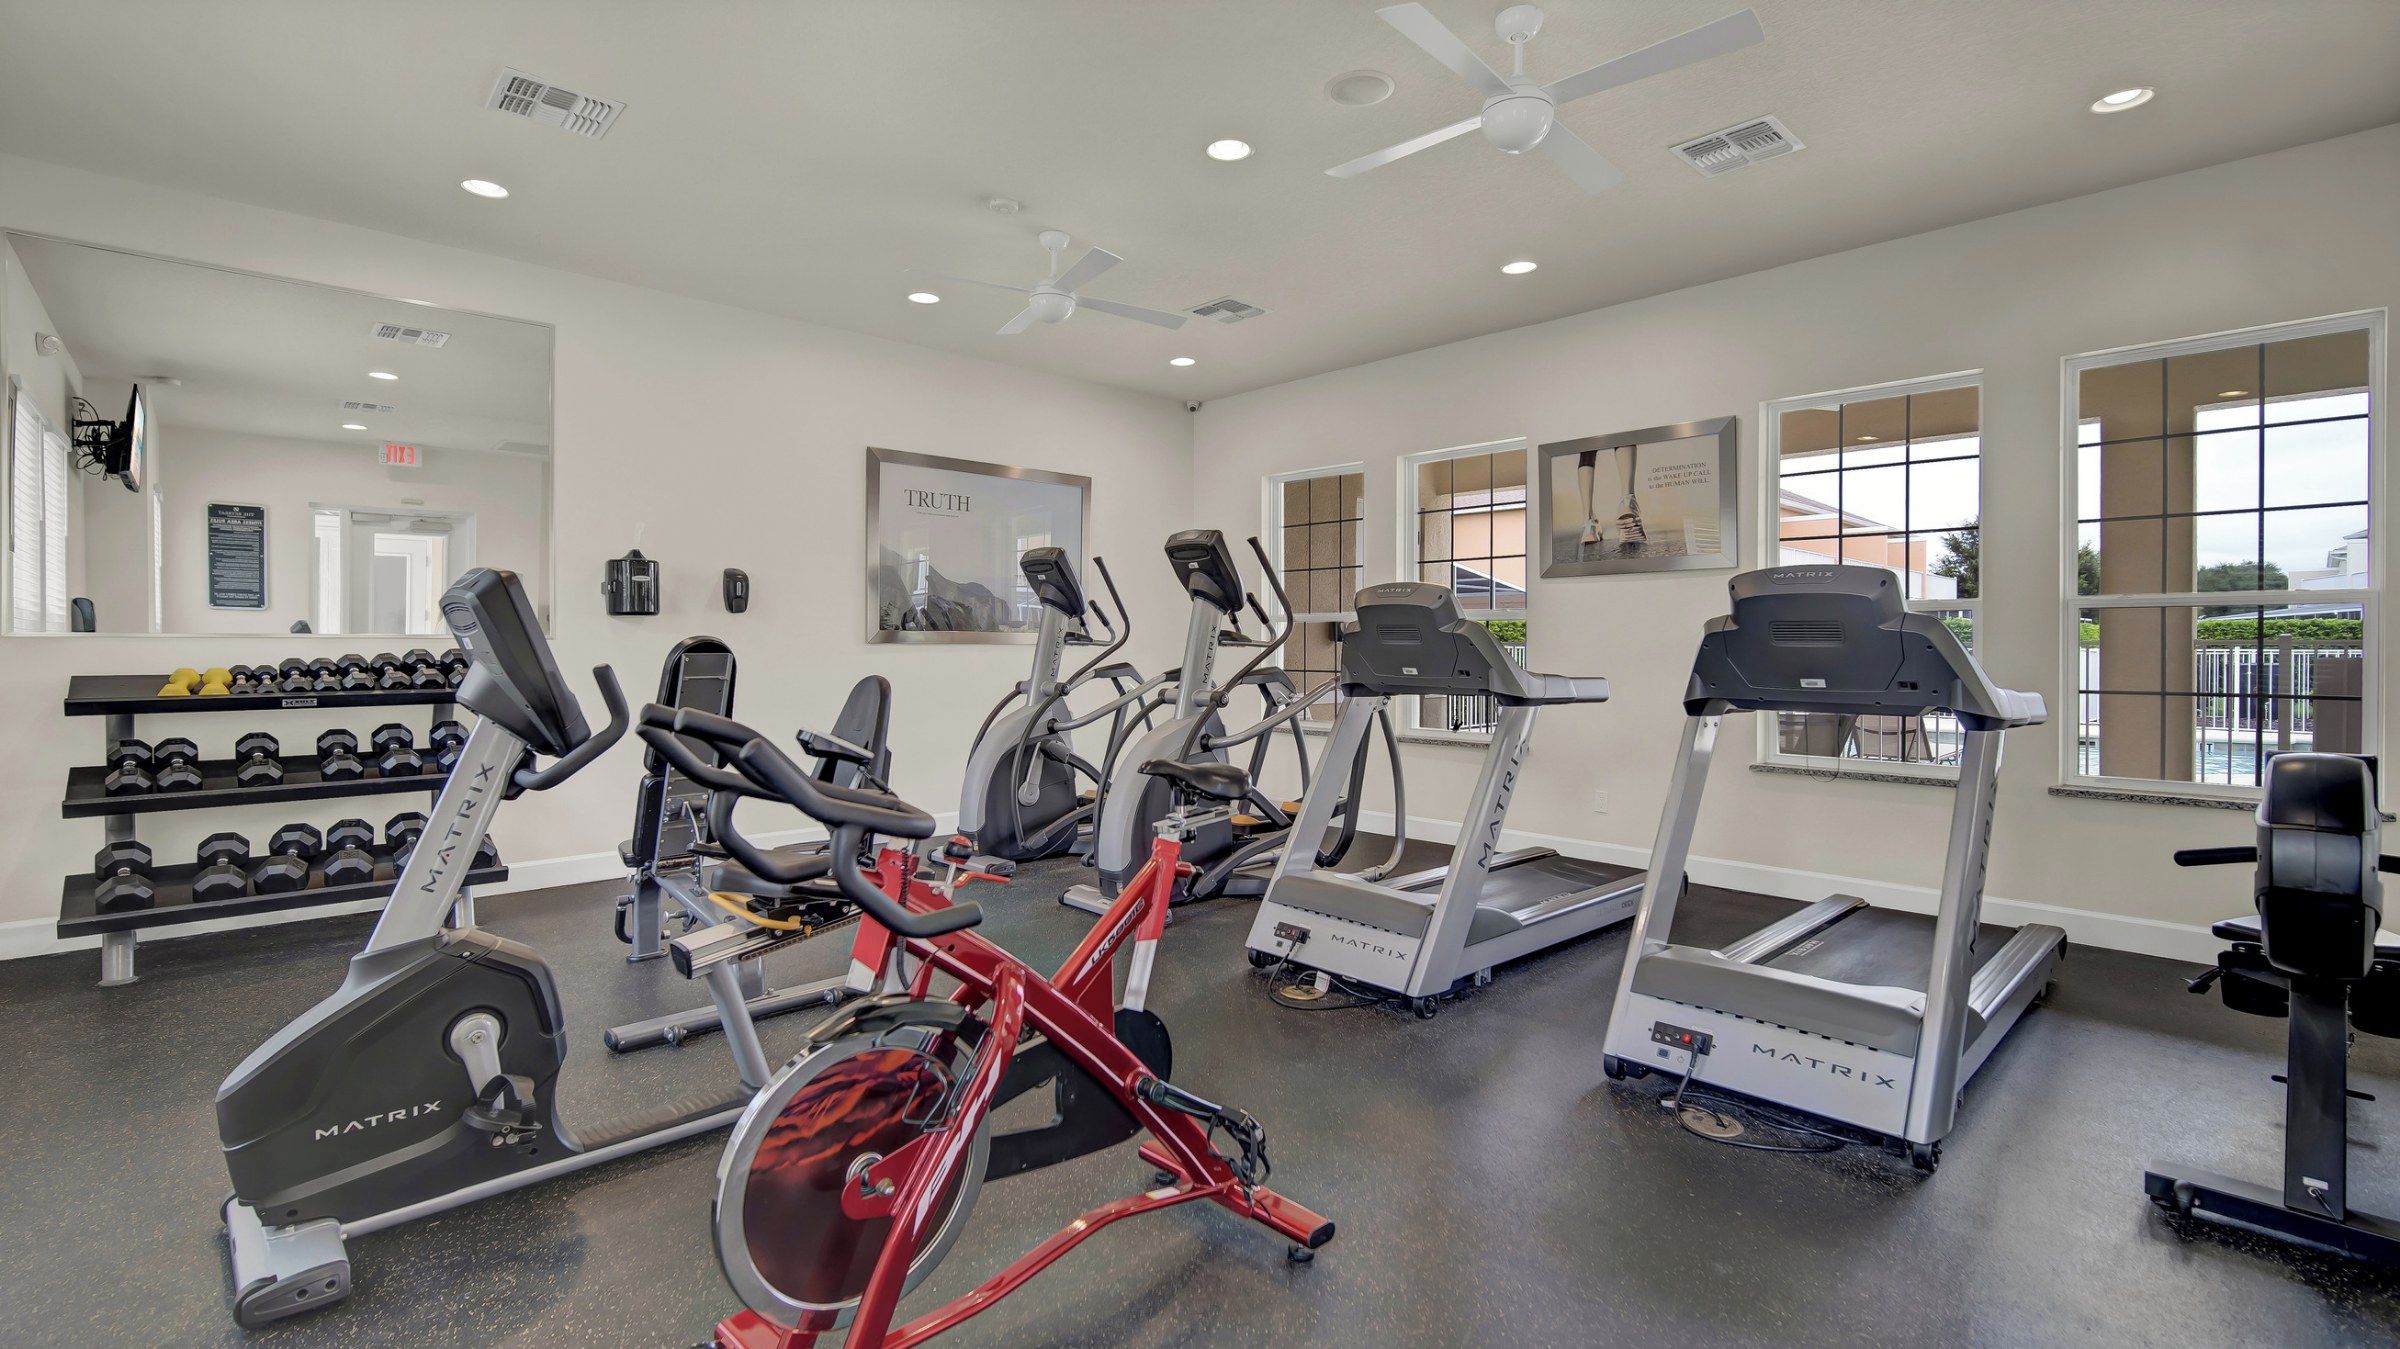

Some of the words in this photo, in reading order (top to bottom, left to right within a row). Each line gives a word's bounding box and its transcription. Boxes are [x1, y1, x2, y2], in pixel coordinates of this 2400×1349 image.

[1652, 462, 1706, 474] DETERMINATION
[1662, 472, 1682, 480] WAKE
[1693, 469, 1711, 477] CALL
[1664, 479, 1690, 488] HUMAN
[904, 490, 970, 512] TRUTH
[1773, 571, 1833, 579] MATRIX
[1050, 627, 1063, 677] MATRIX
[1202, 625, 1217, 684] MATRIX
[1478, 733, 1527, 869] MATRIX
[420, 763, 495, 893] MATRIX
[1331, 934, 1408, 961] MATRIX
[1752, 1043, 1896, 1089] MATRIX
[315, 1100, 441, 1141] MATRIX
